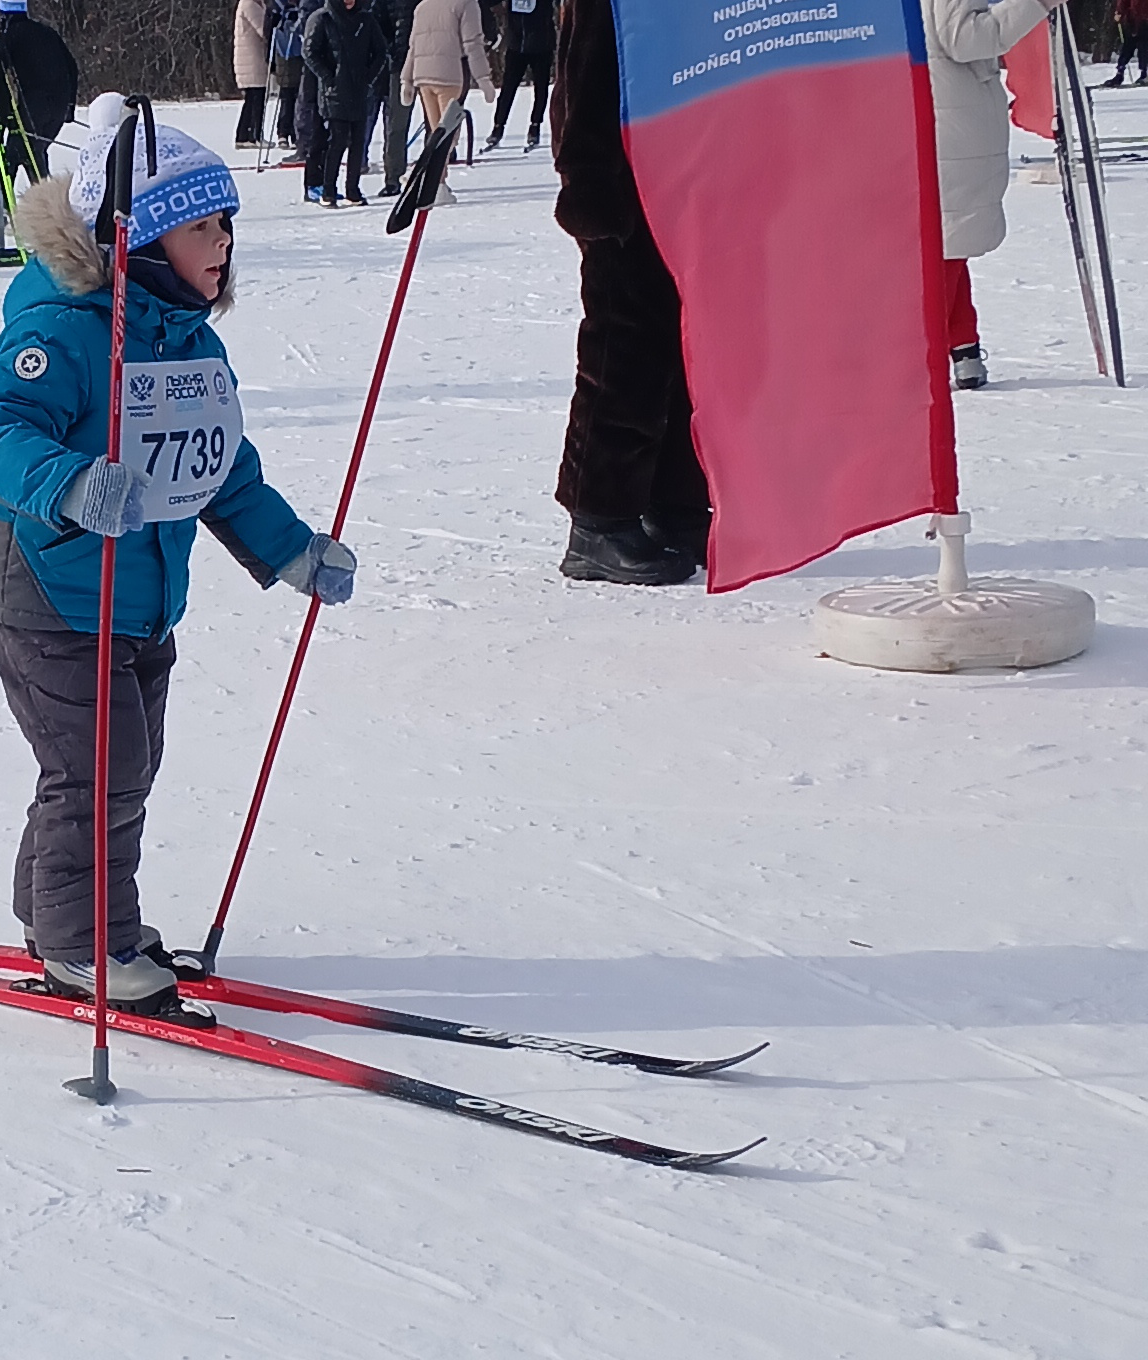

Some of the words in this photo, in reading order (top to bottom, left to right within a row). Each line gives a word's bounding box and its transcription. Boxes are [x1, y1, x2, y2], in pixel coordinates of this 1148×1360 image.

[148, 179, 237, 222] РОССИ
[166, 373, 204, 387] ЛЫЖНЯ
[166, 386, 209, 401] РОССИИ
[142, 426, 225, 481] 7739
